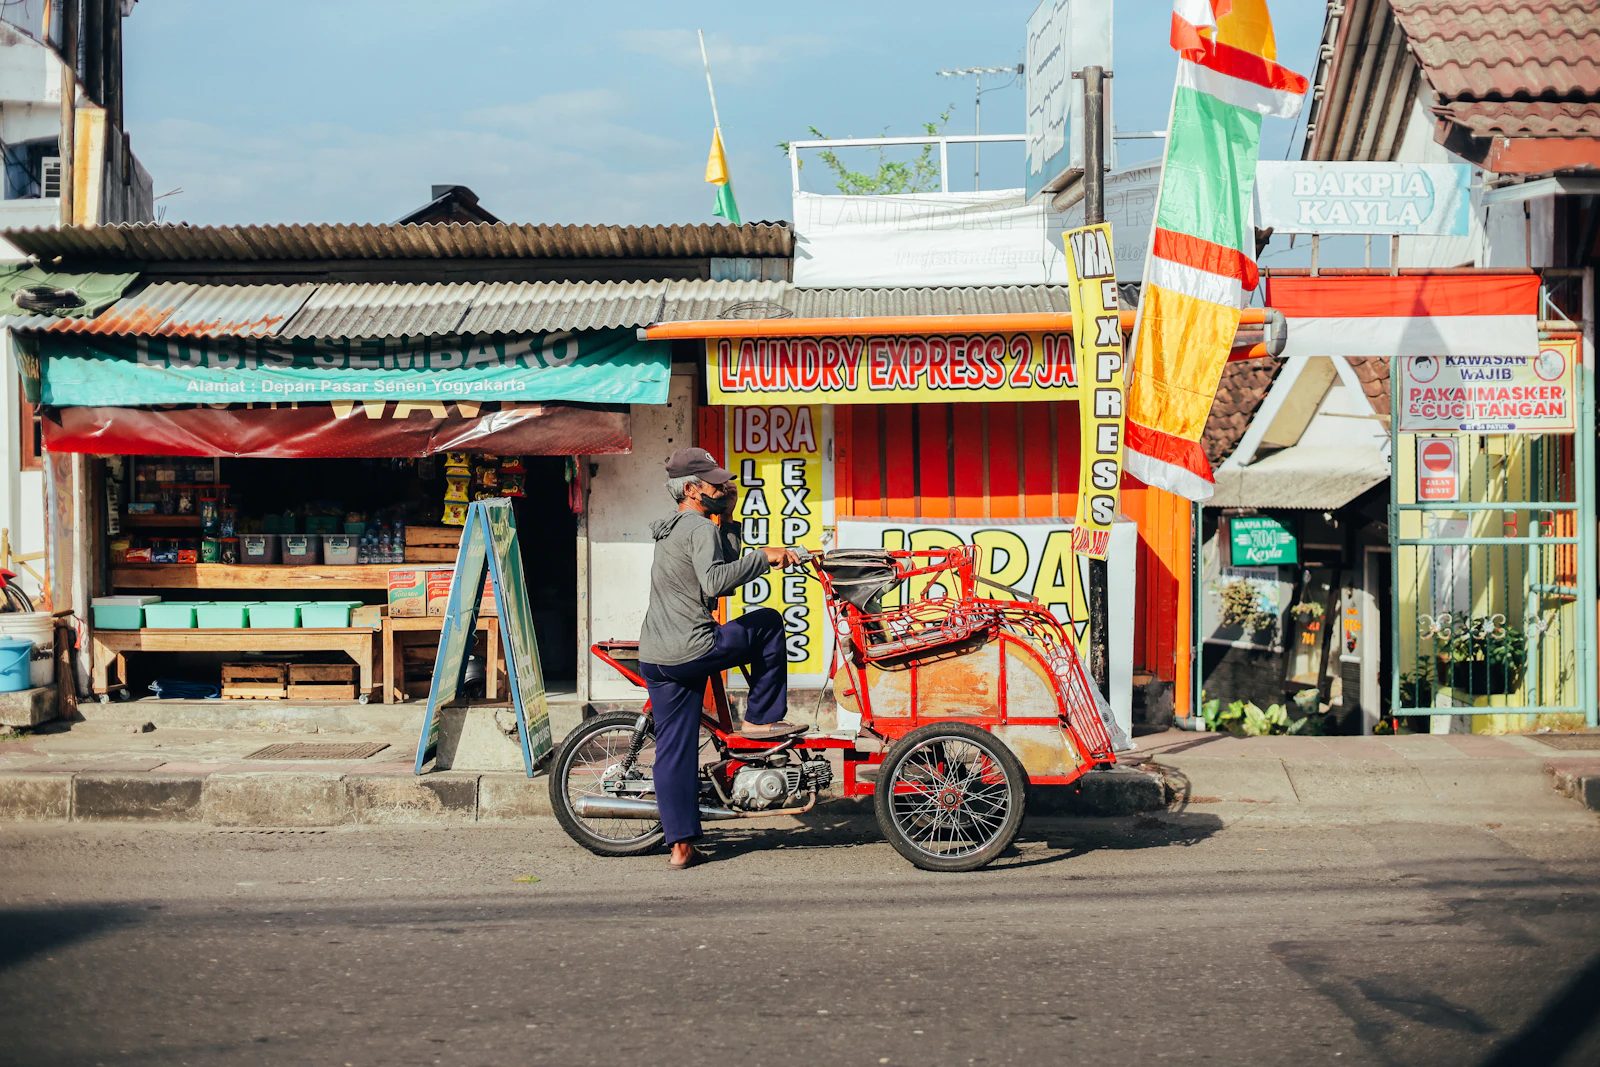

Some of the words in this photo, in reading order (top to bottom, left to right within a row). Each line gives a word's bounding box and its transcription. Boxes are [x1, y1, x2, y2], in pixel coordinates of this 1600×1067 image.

[1292, 171, 1430, 198] BAKPIA
[1297, 200, 1423, 226] KAYLA
[136, 334, 295, 370] LUBIS
[312, 330, 579, 370] SEMBAKO
[1445, 356, 1528, 366] KAWASAN
[718, 337, 864, 393] LAUNDRY
[866, 335, 1006, 391] EXPRESS
[1008, 335, 1034, 388] 2
[1035, 333, 1080, 388] JA
[1460, 368, 1513, 381] WAJIB
[186, 379, 246, 393] Alamat
[261, 379, 316, 396] Depan
[320, 379, 369, 393] Pasar
[373, 379, 427, 393] Senen
[431, 377, 526, 395] Yogyakarta
[1410, 387, 1474, 402] PAKAI
[1477, 386, 1565, 401] MASKER
[1090, 278, 1122, 527] EXPRESS
[1475, 402, 1566, 418] TANGAN
[733, 405, 817, 454] IBRA
[1250, 529, 1277, 548] 704
[1246, 546, 1283, 562] Kayla
[881, 528, 1091, 624] IBRA
